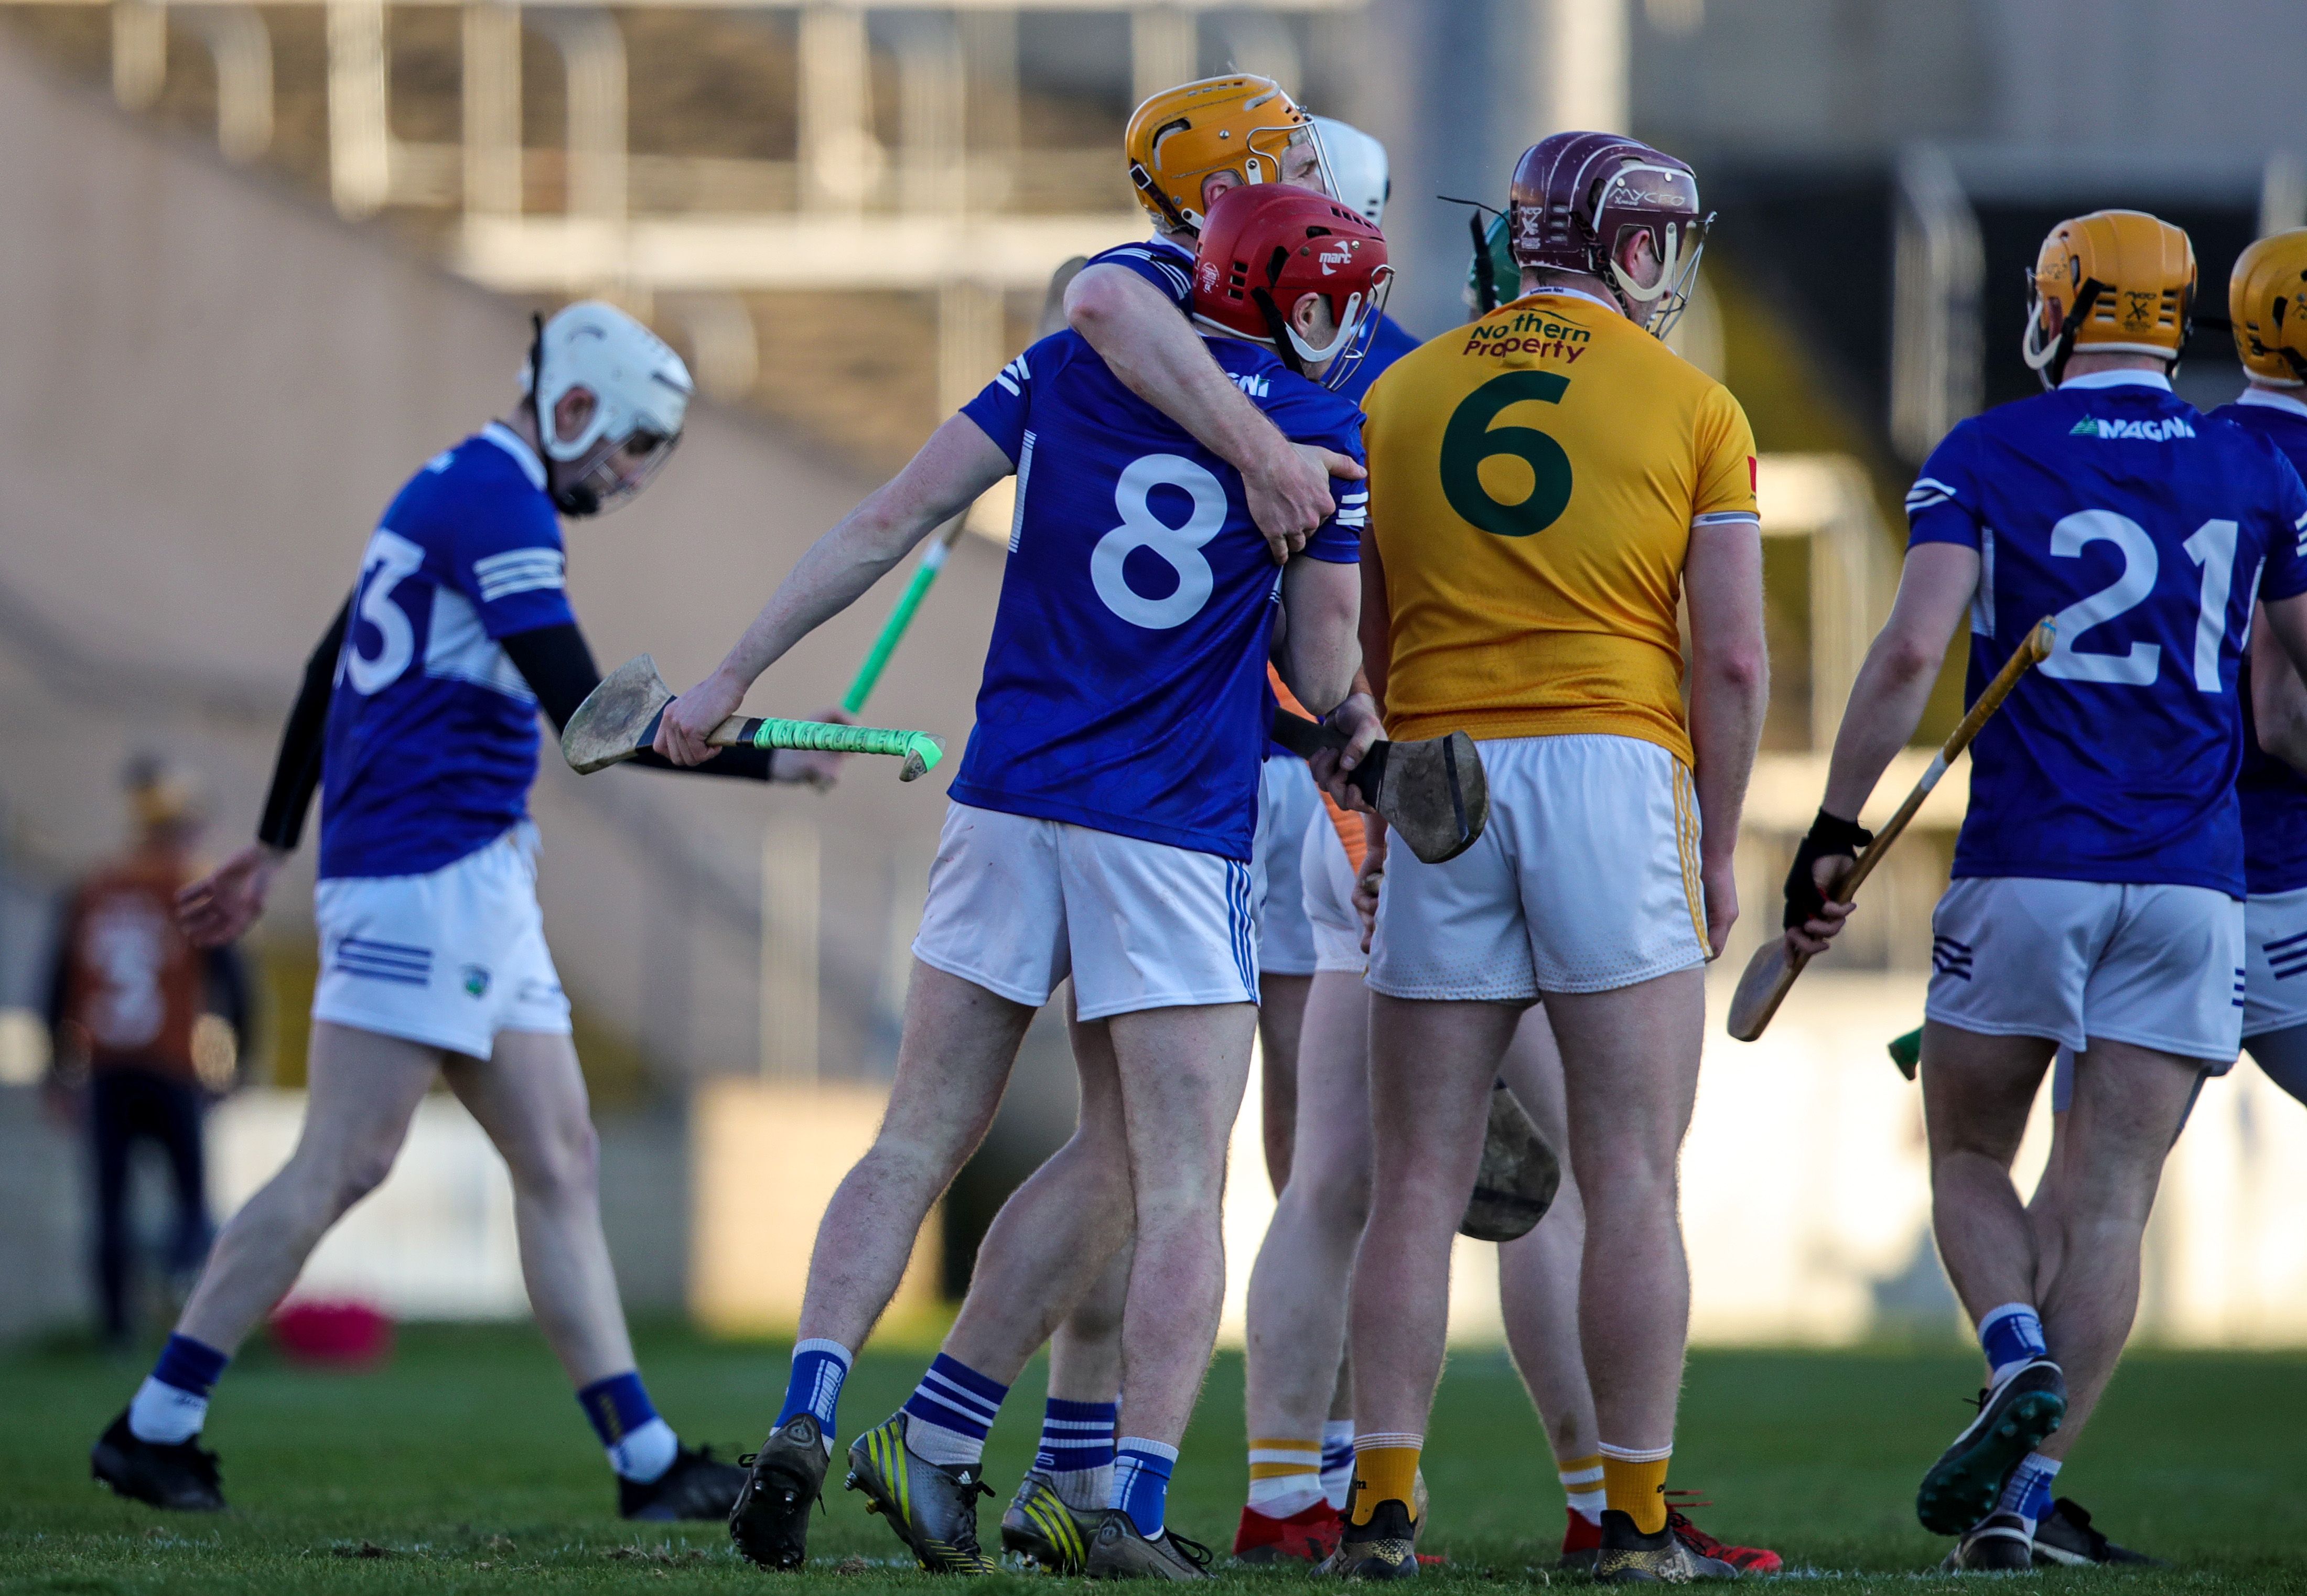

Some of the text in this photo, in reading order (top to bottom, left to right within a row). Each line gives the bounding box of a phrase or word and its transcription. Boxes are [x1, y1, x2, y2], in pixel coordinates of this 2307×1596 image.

[1462, 337, 1586, 364] Property
[1471, 313, 1591, 343] Nothern
[1440, 370, 1573, 537] 6
[1090, 453, 1228, 630] 8
[2036, 509, 2238, 693] 21
